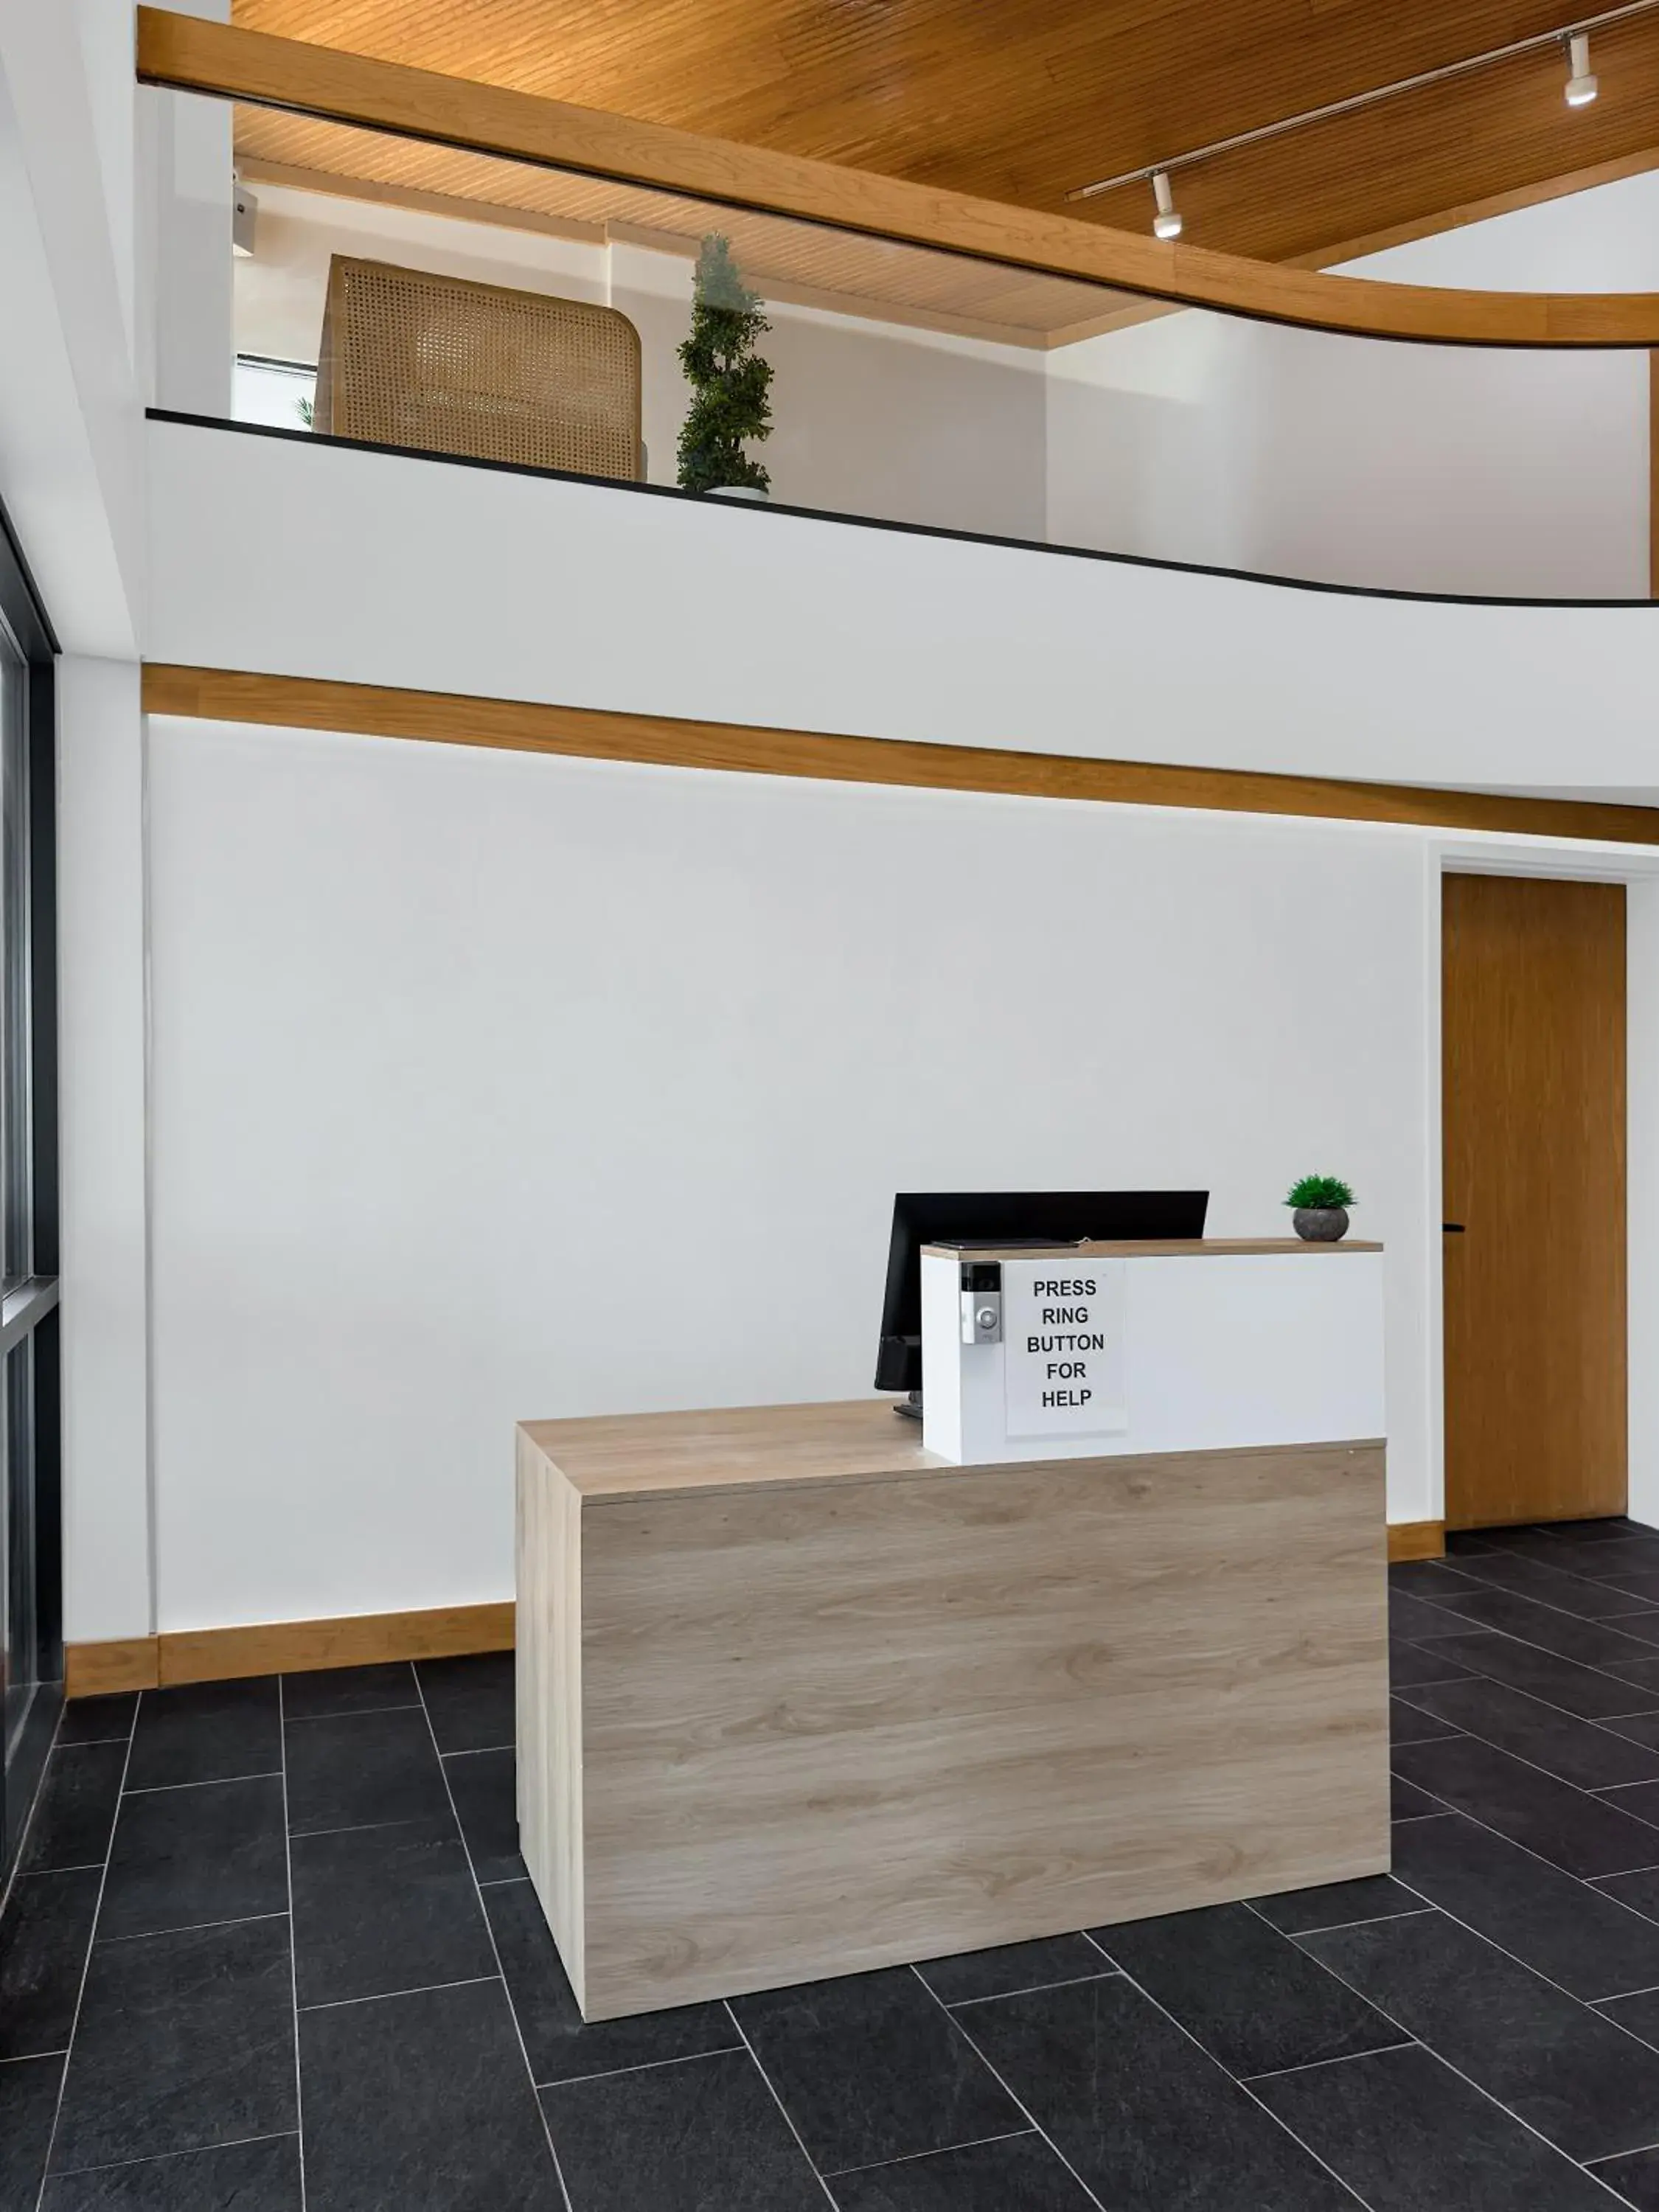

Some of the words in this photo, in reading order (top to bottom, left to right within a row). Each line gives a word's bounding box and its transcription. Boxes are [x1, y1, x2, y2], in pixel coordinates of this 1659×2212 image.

[1034, 1279, 1096, 1297] PRESS
[1043, 1307, 1088, 1325] RING
[1027, 1334, 1104, 1353] BUTTON
[1047, 1362, 1086, 1380] FOR
[1042, 1389, 1092, 1408] HELP
